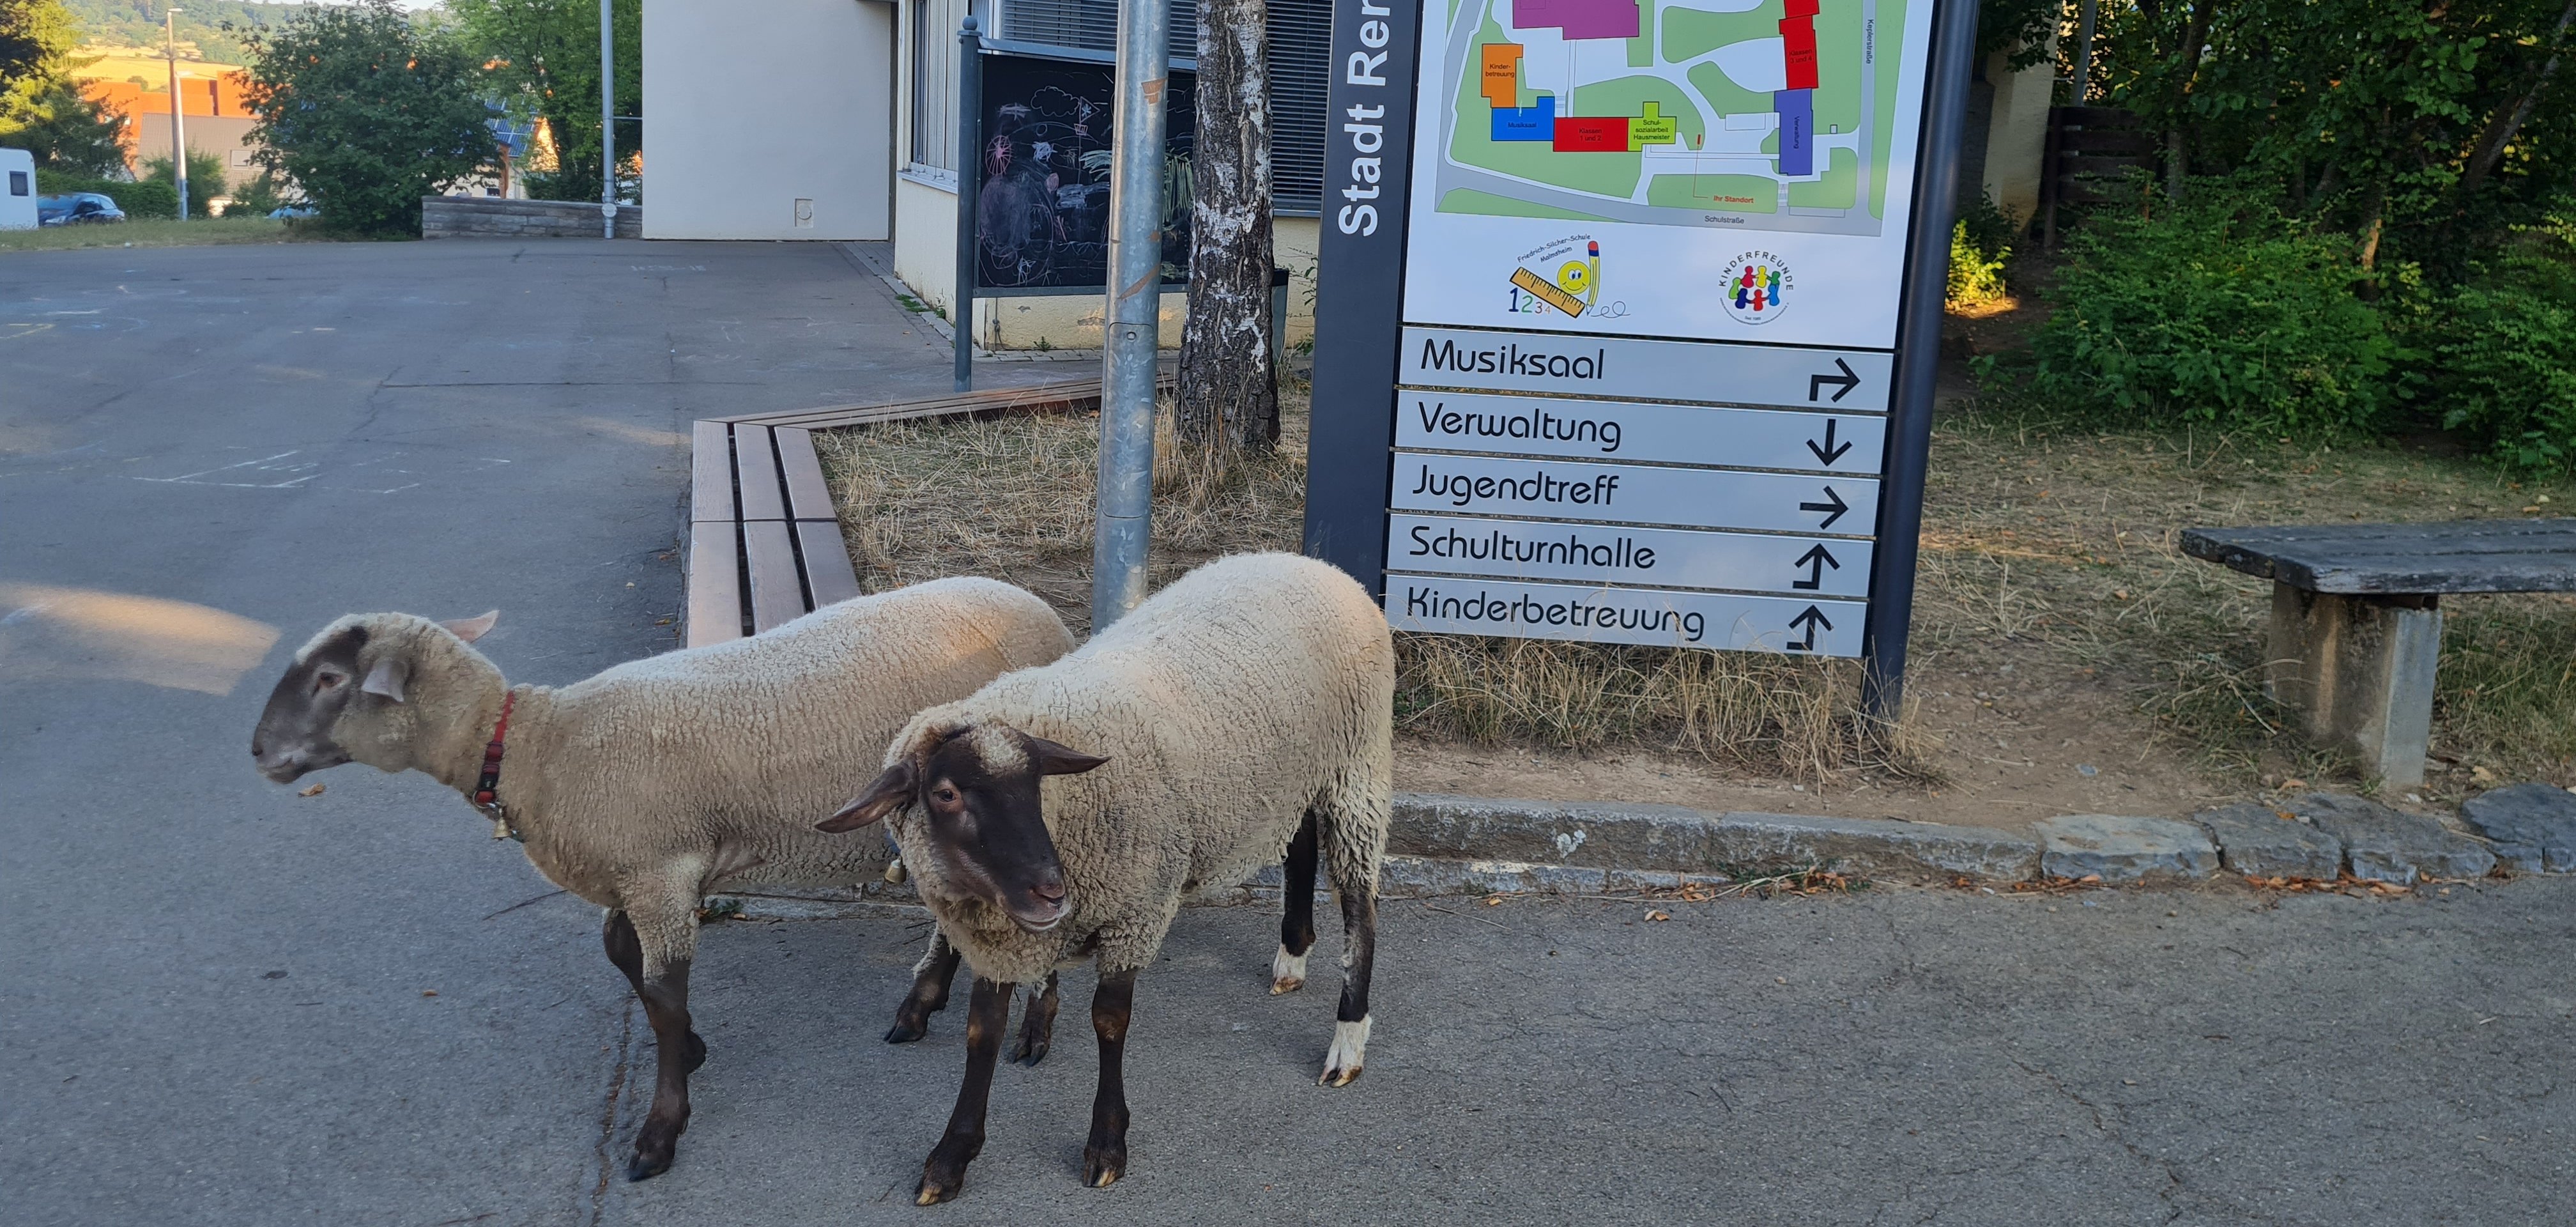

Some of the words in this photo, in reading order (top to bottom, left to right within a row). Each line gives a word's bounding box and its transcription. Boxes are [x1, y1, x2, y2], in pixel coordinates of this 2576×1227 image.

[1866, 19, 1874, 64] Keplerstraße
[1338, 104, 1385, 236] Stadt
[1705, 215, 1744, 224] Schulstraße
[1517, 234, 1591, 263] Friedrich-Silcher-Schule
[1540, 246, 1572, 263] Malmsheim
[1719, 251, 1793, 291] KINDERFREUNDE
[1421, 338, 1604, 379] Musiksaal
[1418, 401, 1621, 452] Verwaltung
[1413, 465, 1620, 506] Jugendtreff
[1409, 525, 1656, 569] Schulturnhalle
[1407, 586, 1705, 642] Kinderbetreuung
